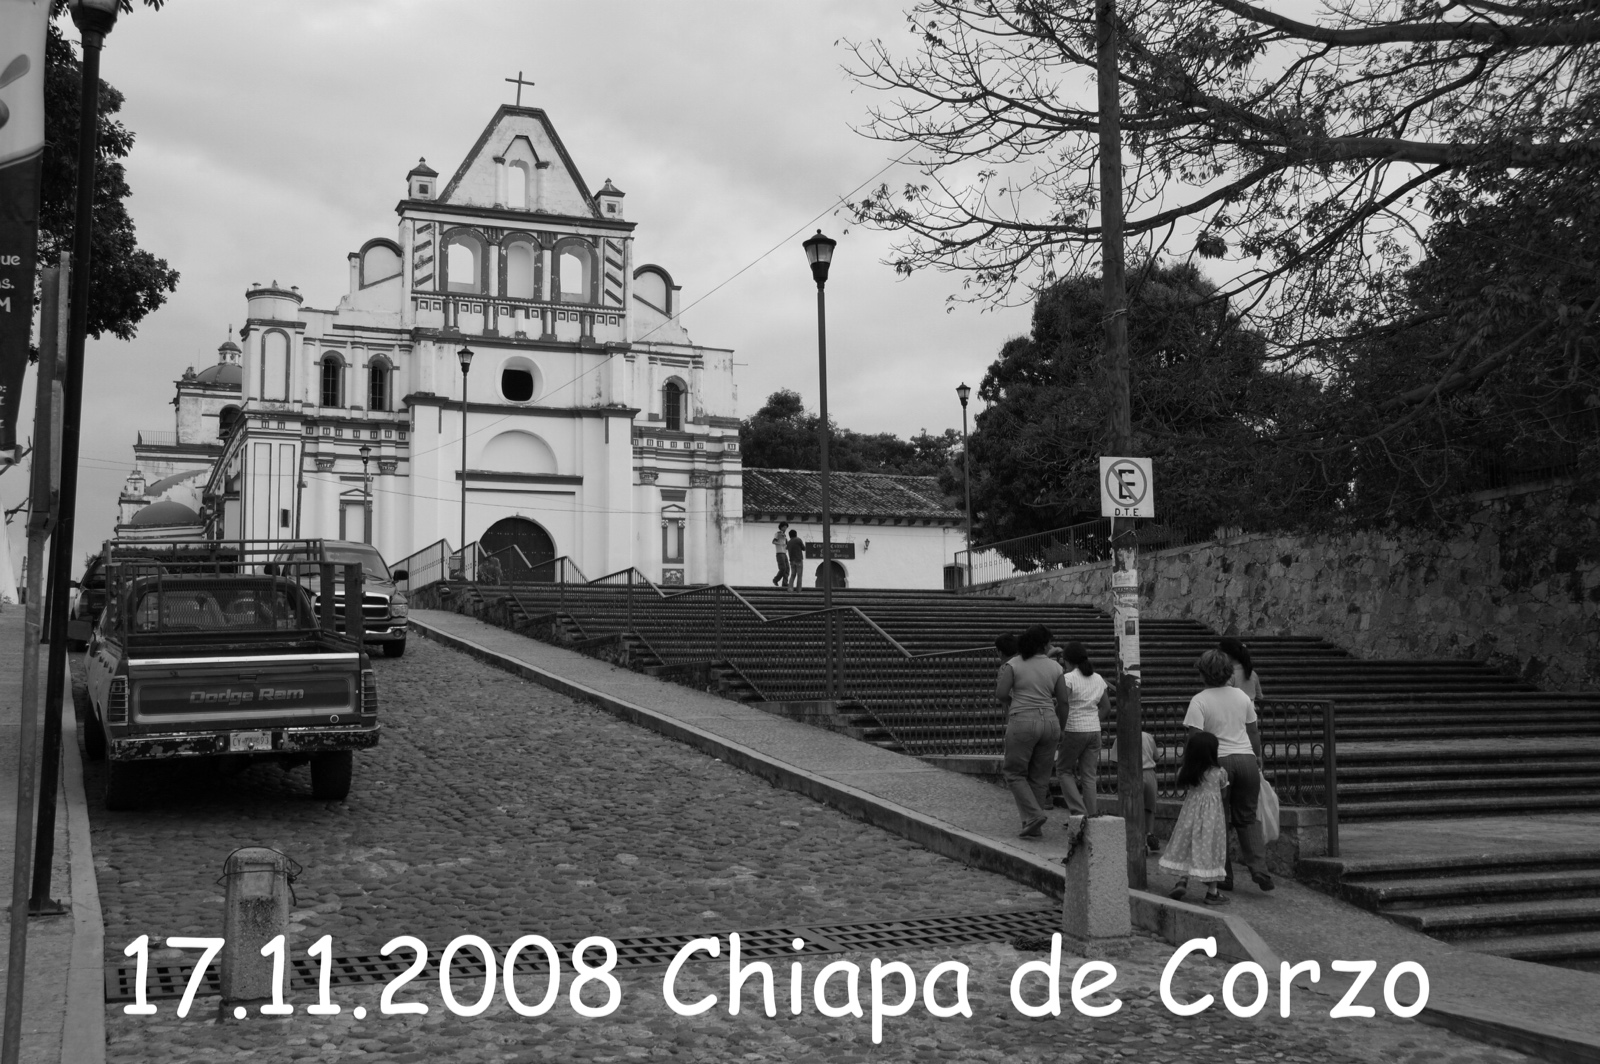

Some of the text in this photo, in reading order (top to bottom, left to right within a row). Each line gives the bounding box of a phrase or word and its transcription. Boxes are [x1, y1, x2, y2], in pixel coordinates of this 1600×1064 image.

[1115, 507, 1142, 517] D.T.E.
[189, 688, 305, 706] Dodge Ram
